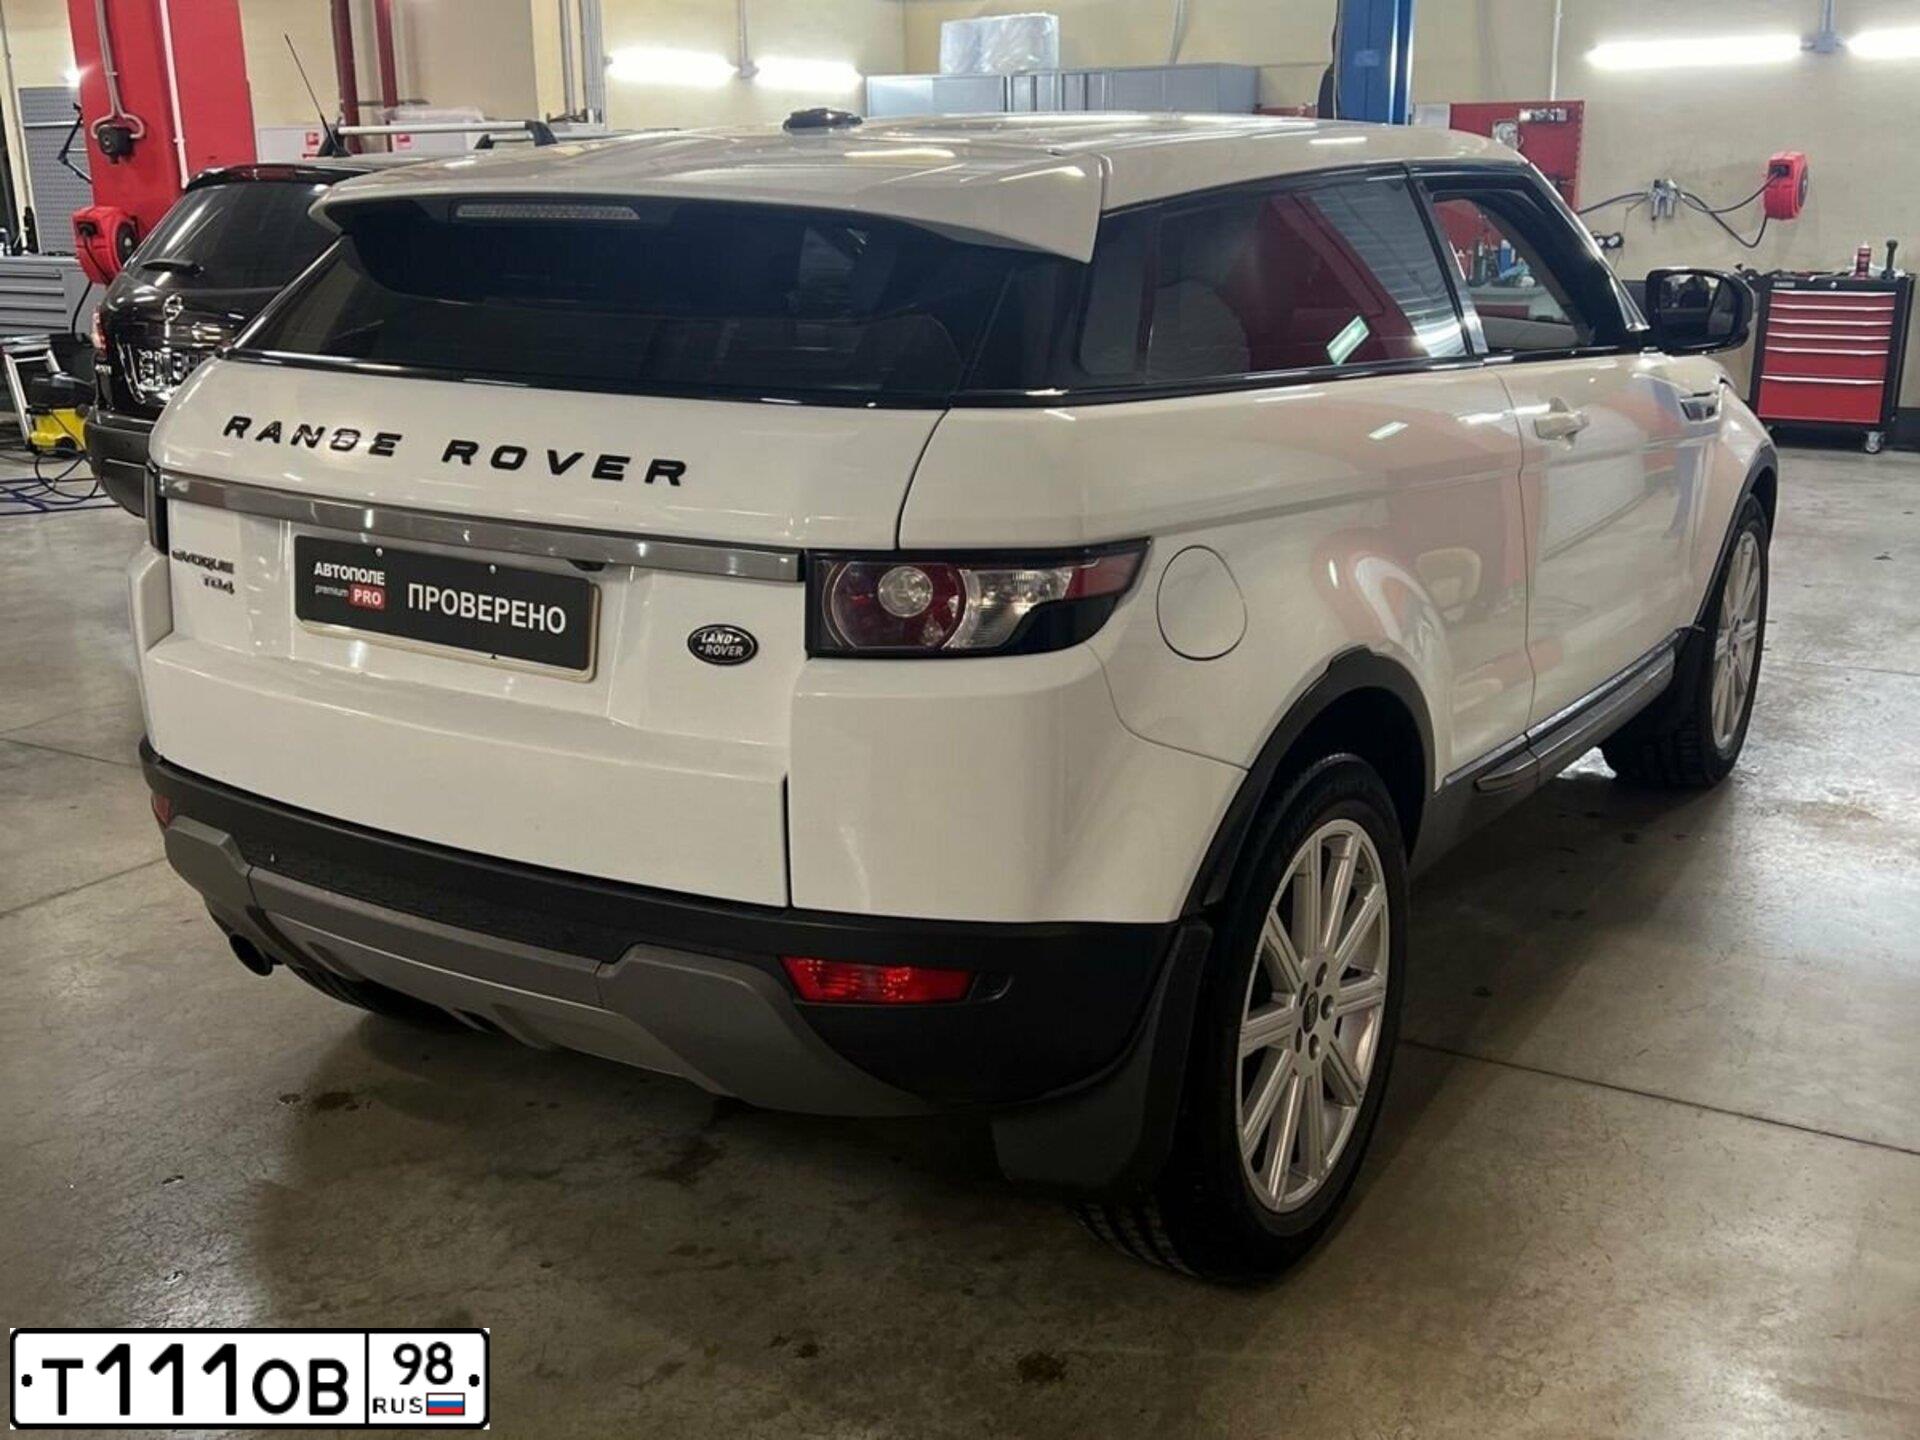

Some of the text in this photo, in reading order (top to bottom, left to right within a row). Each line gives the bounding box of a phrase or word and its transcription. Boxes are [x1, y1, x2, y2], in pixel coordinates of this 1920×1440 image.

[223, 415, 688, 487] RANGE ROVER
[314, 561, 386, 587] АВТОПОЛЕ
[353, 588, 382, 606] PRO
[408, 582, 567, 635] ПРОВЕРЕНО
[701, 632, 734, 644] LAND
[705, 644, 744, 657] ROVER
